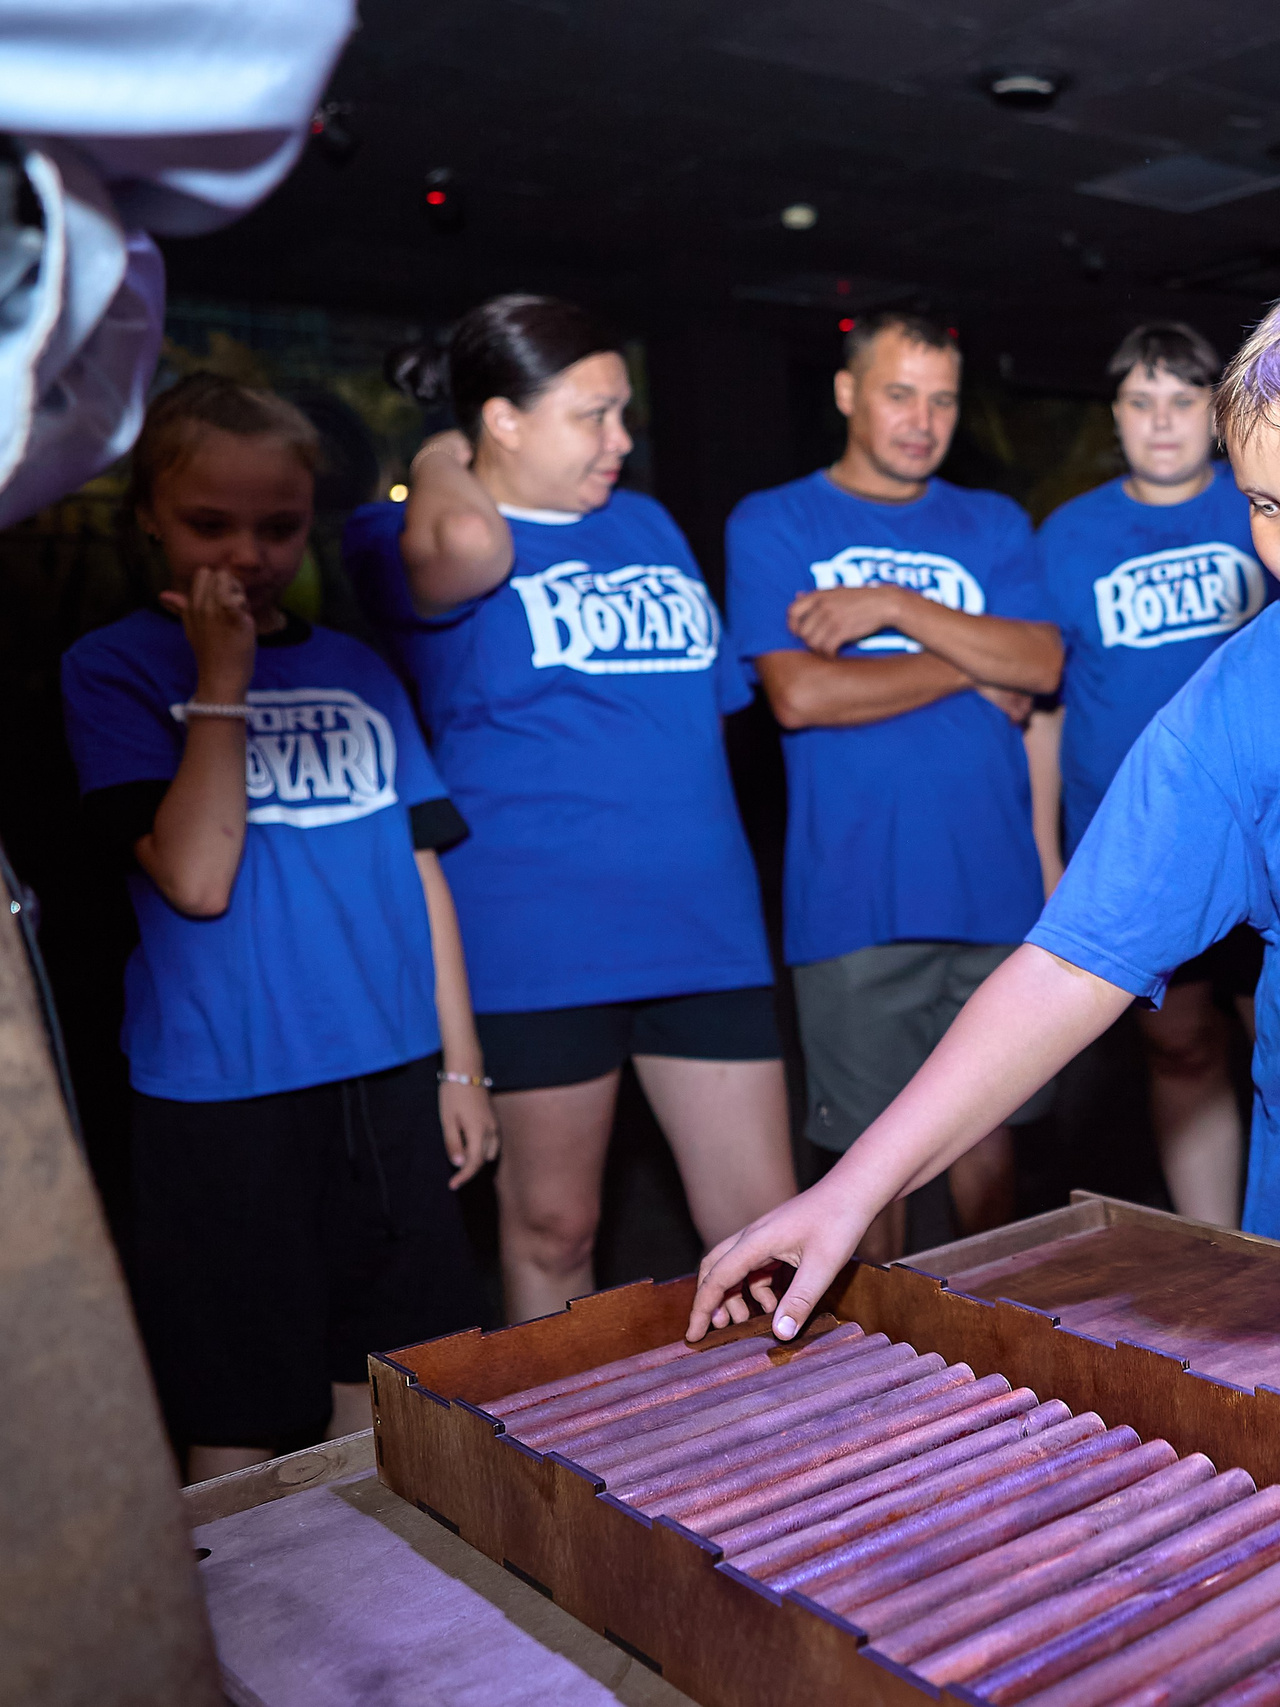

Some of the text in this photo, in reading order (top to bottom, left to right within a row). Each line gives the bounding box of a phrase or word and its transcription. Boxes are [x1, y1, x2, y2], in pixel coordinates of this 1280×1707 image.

[510, 573, 720, 669] BOYARD
[1094, 556, 1266, 648] BOYARD
[246, 705, 339, 731] ORT
[246, 703, 398, 806] OYARD
